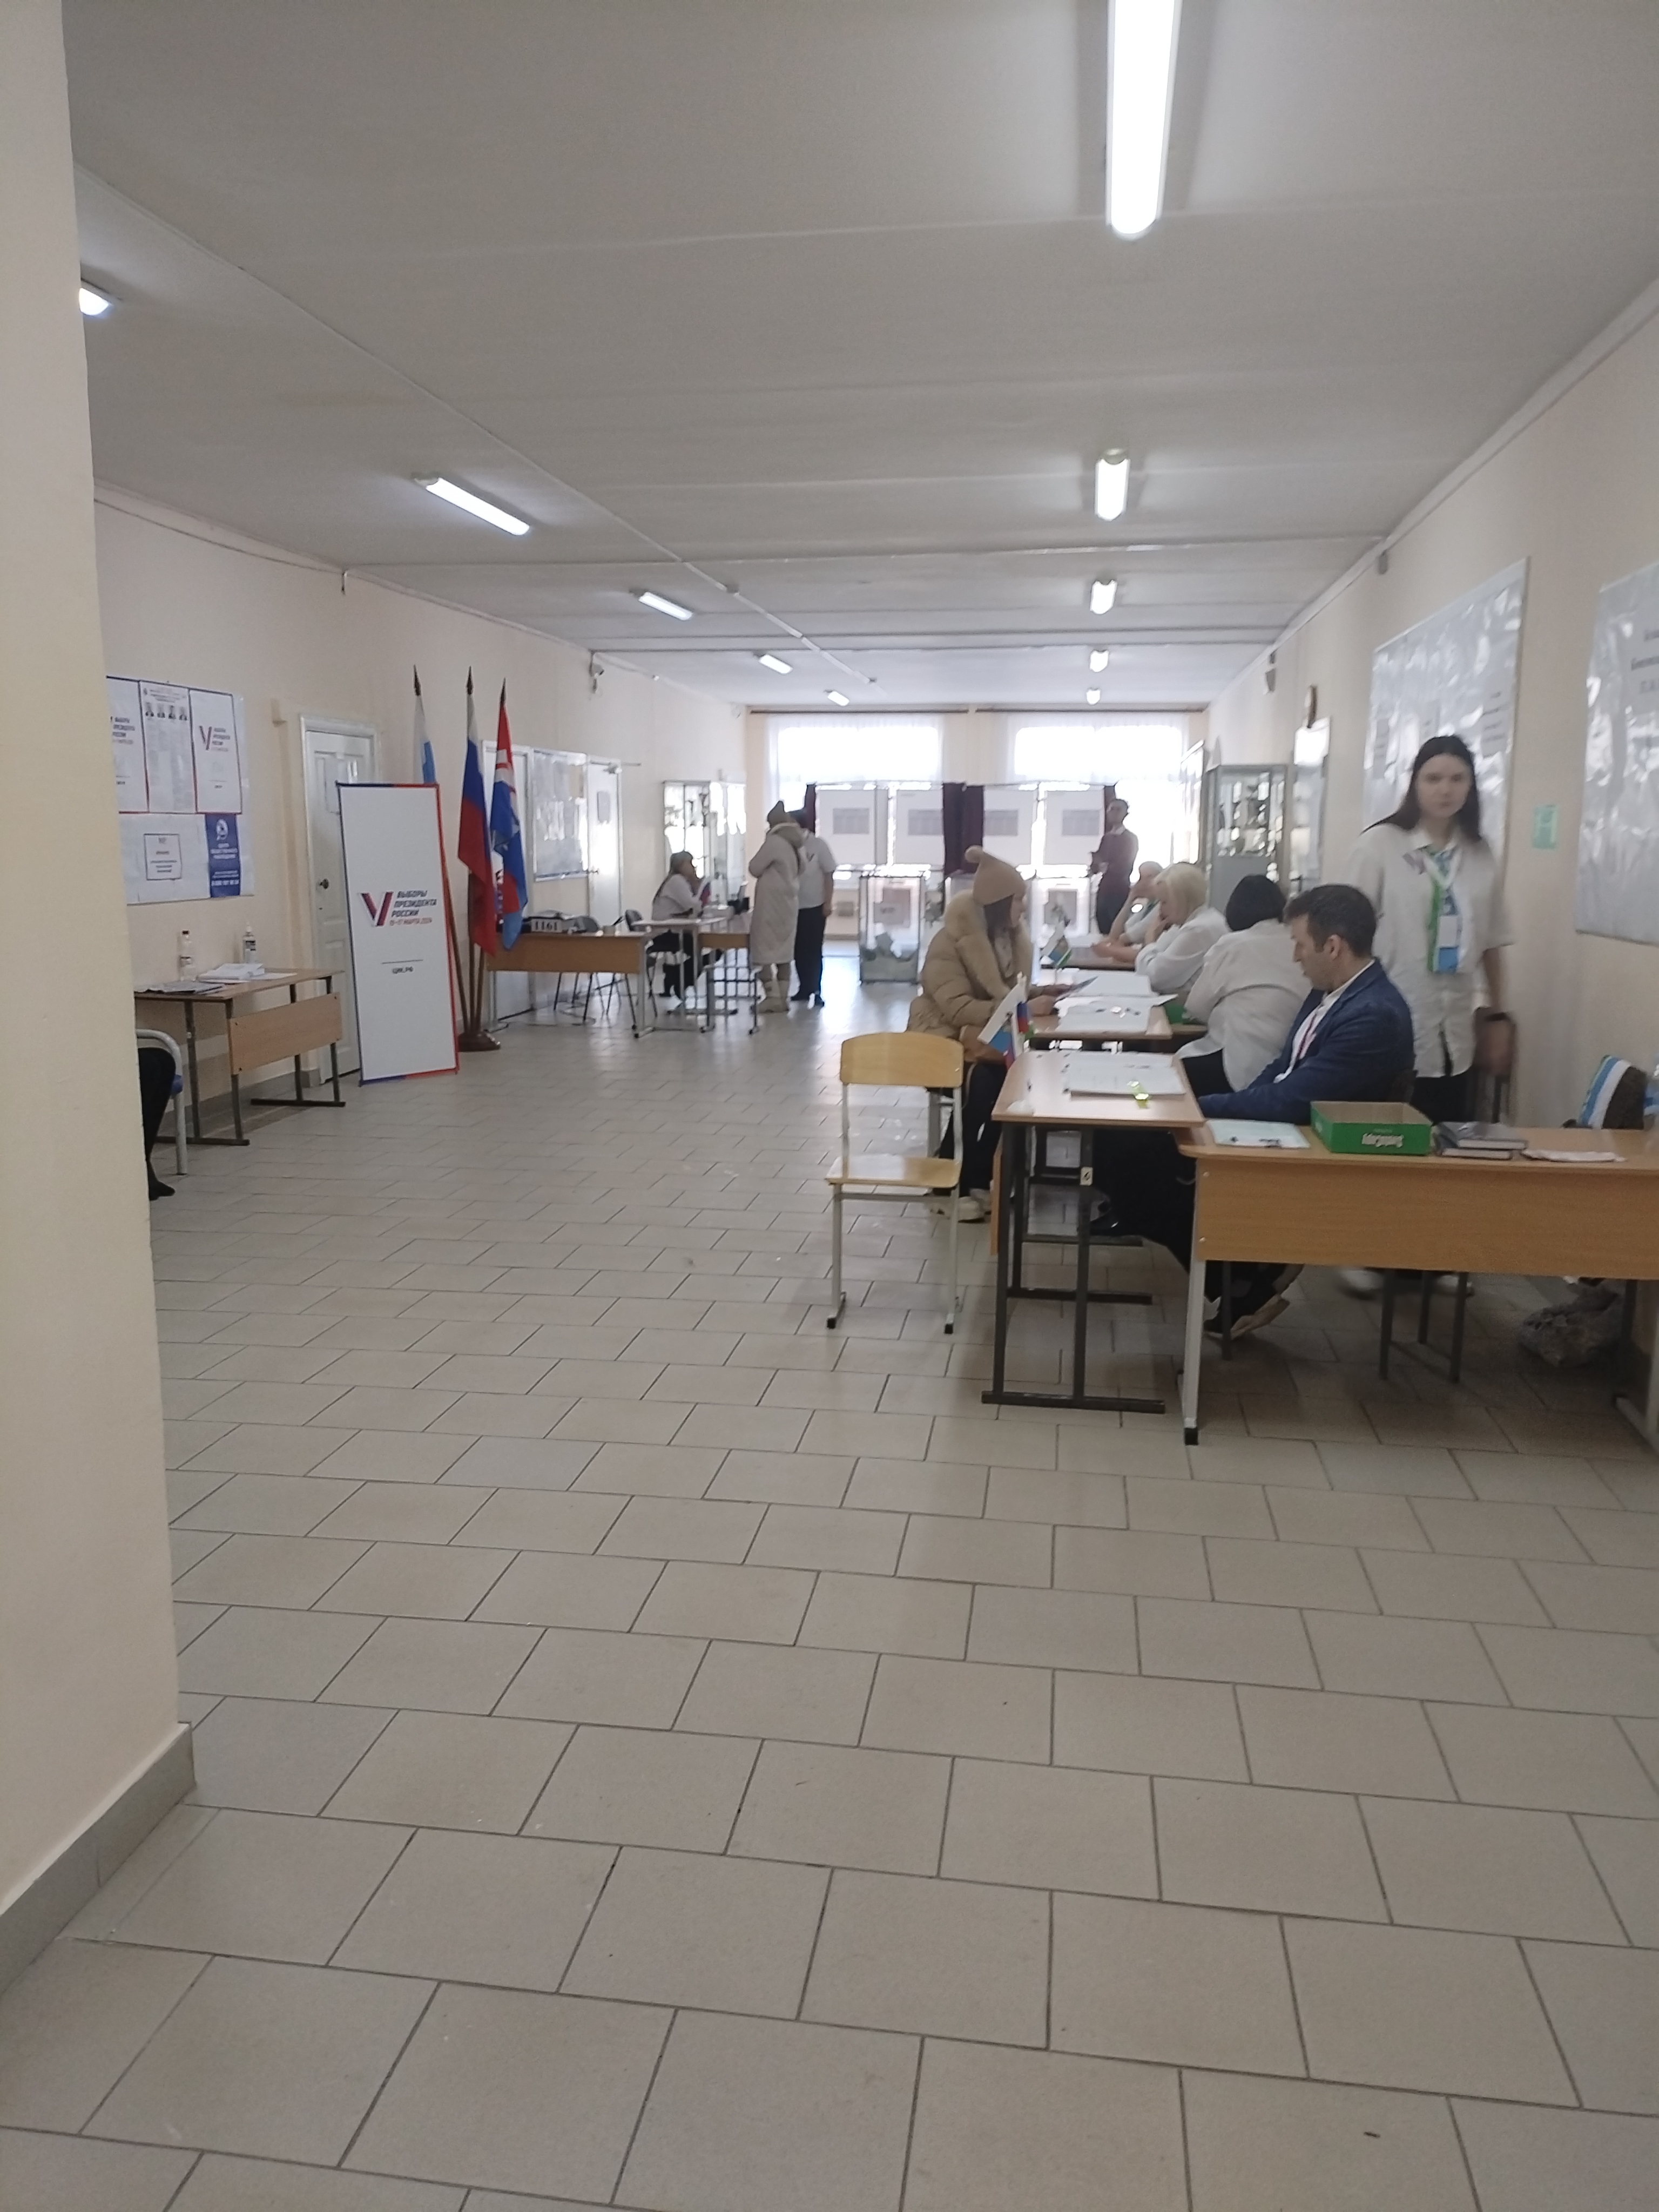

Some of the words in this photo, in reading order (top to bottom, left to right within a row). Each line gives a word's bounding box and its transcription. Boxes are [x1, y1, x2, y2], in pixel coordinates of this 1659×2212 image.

[397, 890, 428, 898] ВЫБОРЫ
[394, 899, 437, 908] ПРЕЗИДЕНТА
[392, 909, 419, 918] РОССИИ
[535, 921, 557, 930] 1161
